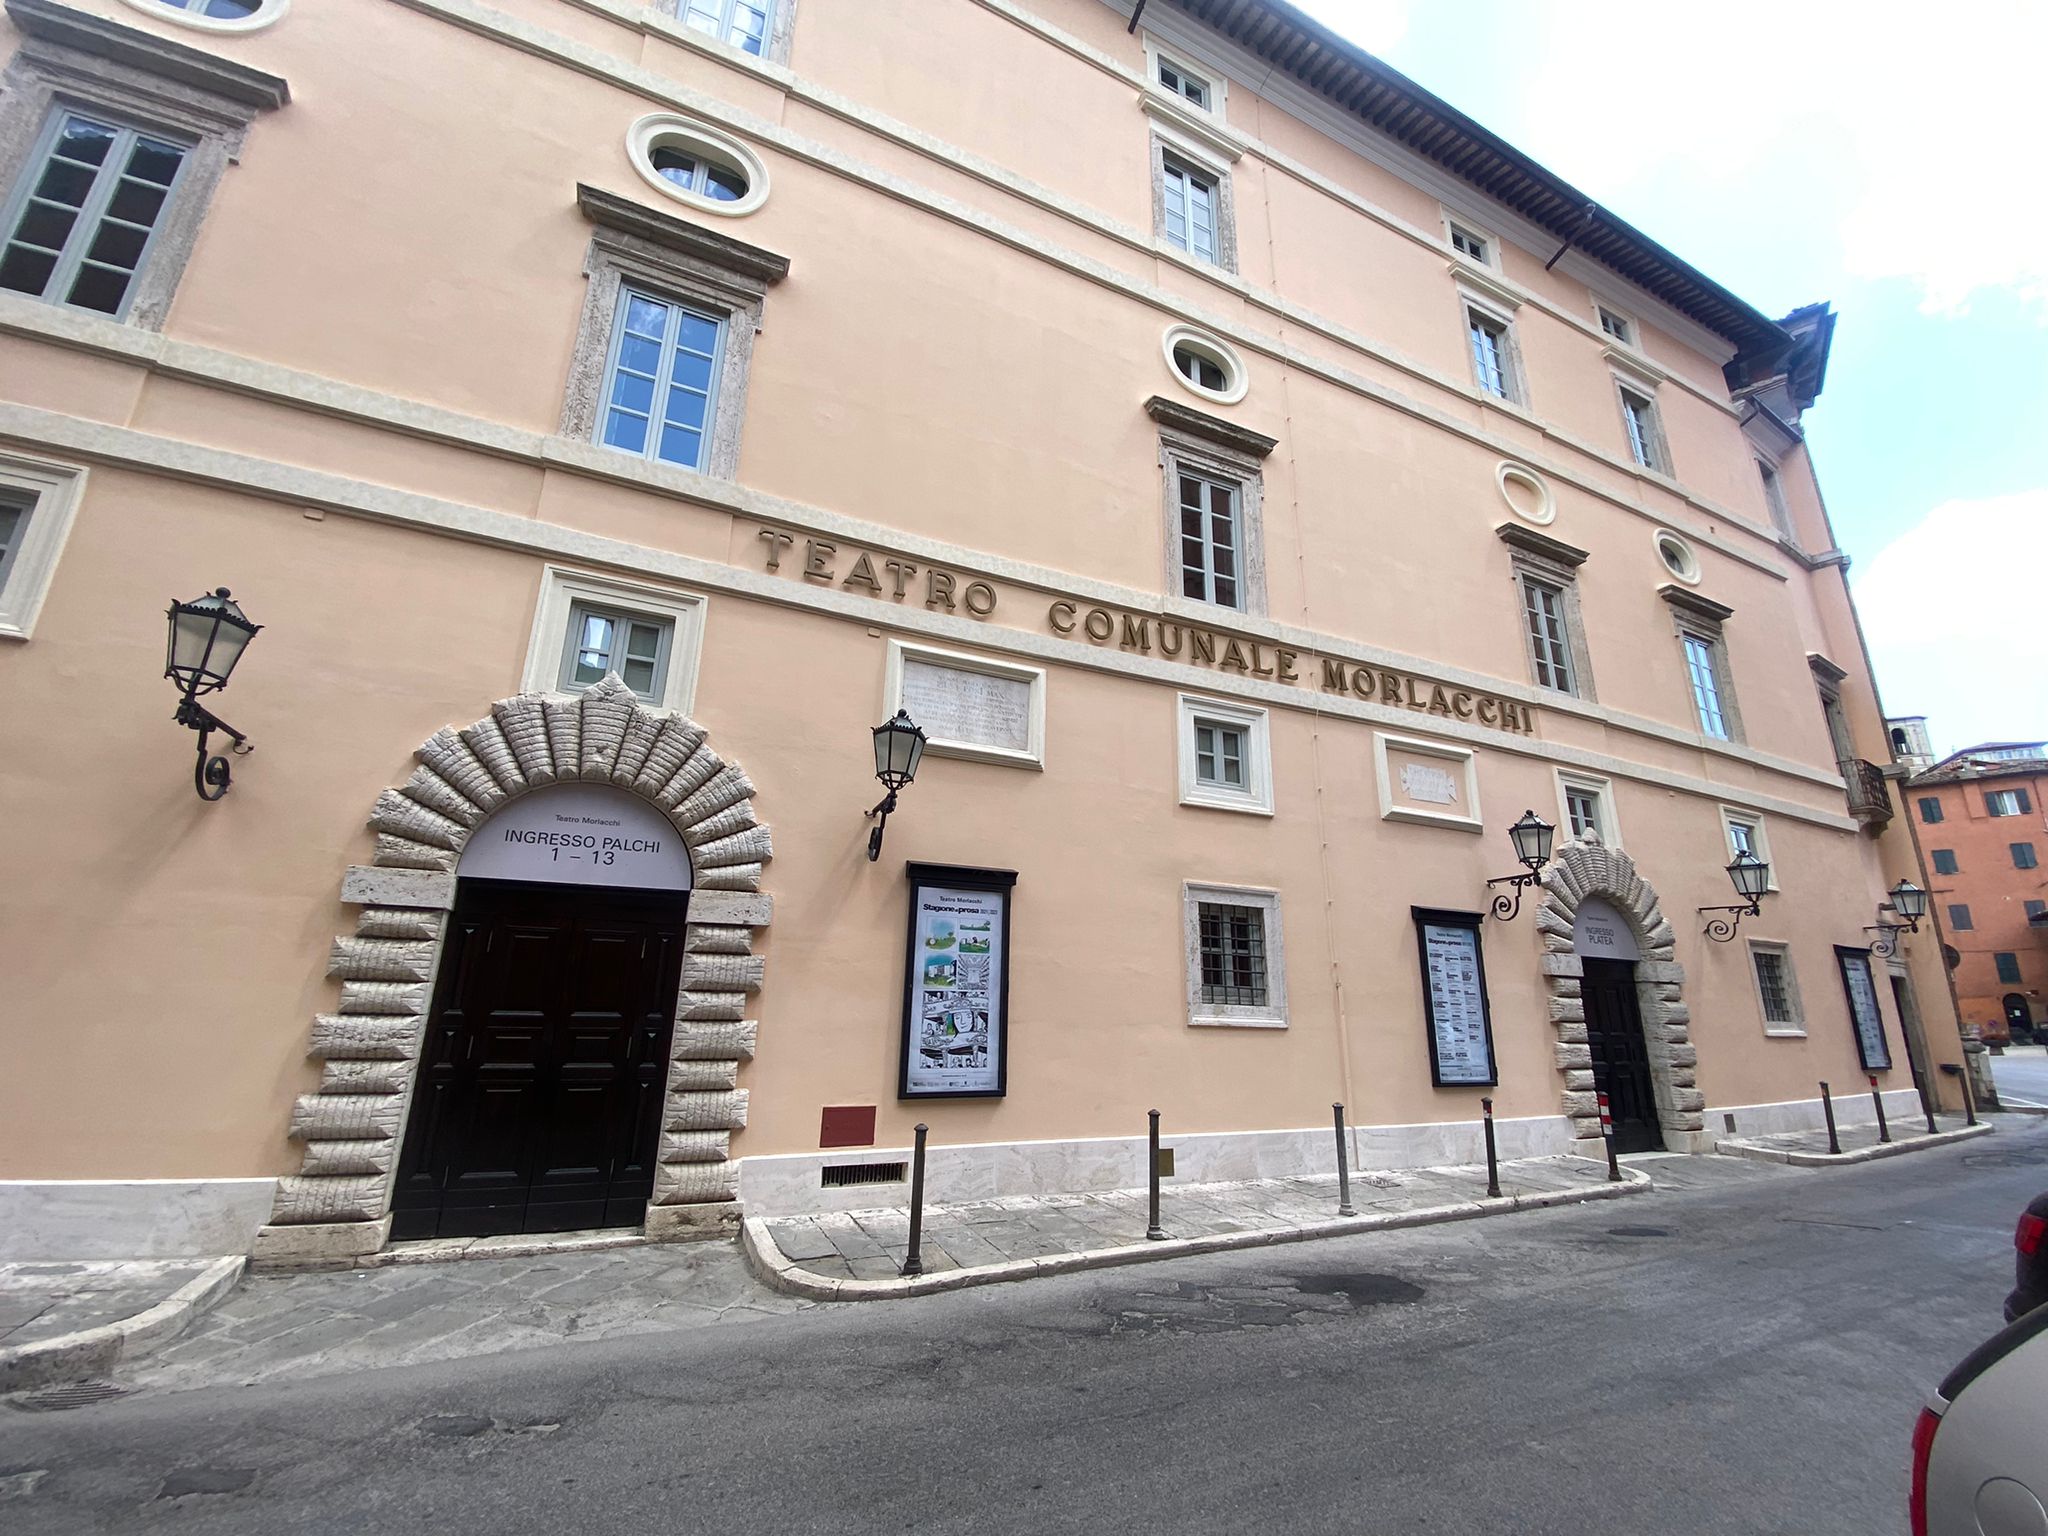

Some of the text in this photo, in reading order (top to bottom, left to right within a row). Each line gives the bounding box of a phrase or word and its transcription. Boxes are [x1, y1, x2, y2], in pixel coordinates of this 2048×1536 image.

[758, 526, 1534, 733] TEATRO COMUNALE MORLACCHI
[555, 814, 621, 827] Teatro Morlacchi
[504, 829, 660, 854] INGRESSO PALCHI
[551, 847, 559, 862] 1
[592, 850, 615, 866] 13
[923, 903, 955, 913] Stagione
[1588, 934, 1614, 946] PLATEA
